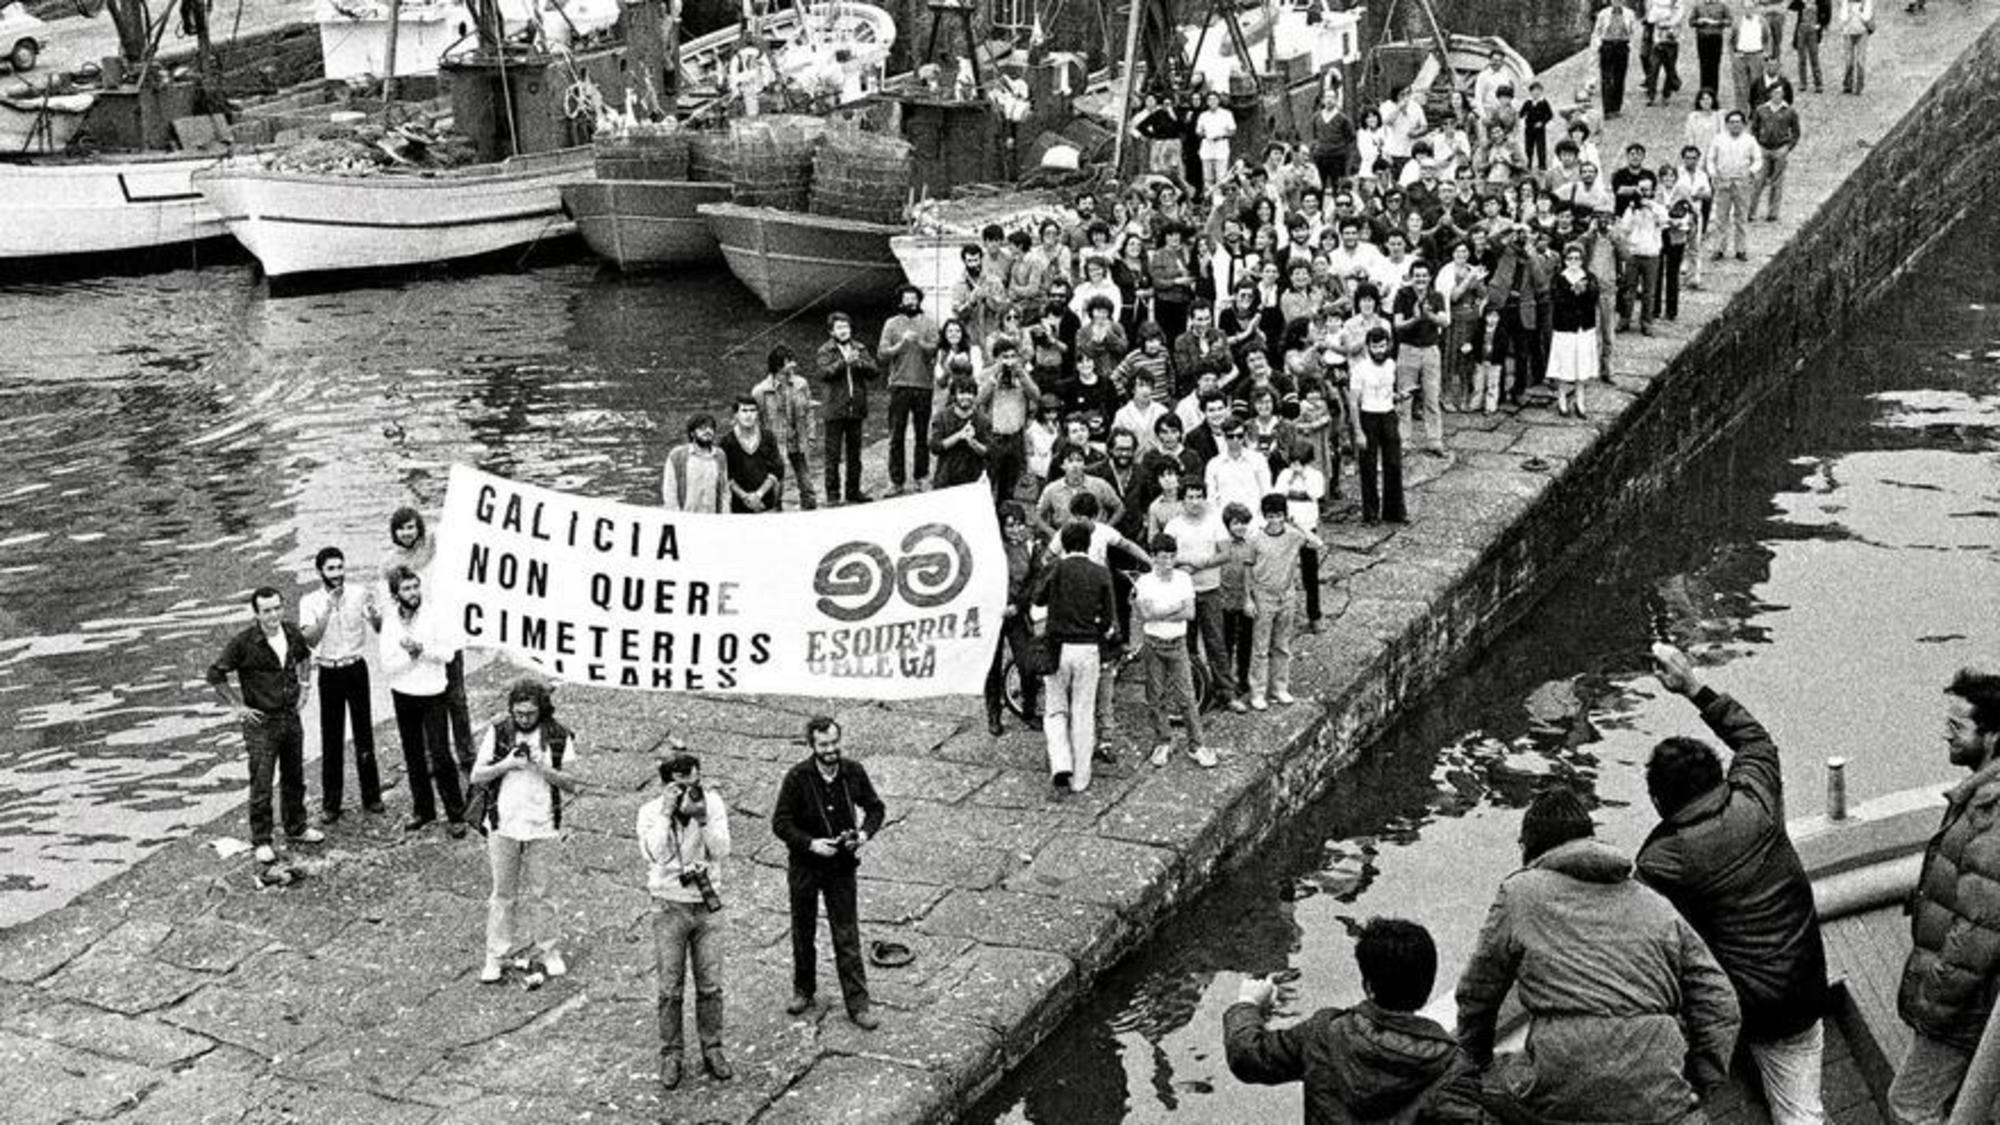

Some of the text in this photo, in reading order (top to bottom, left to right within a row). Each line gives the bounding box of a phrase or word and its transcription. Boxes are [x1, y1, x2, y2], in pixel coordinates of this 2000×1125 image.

[476, 484, 680, 562] GALICIA
[467, 543, 740, 616] NON QUERE
[463, 602, 771, 665] CIMETERIOS
